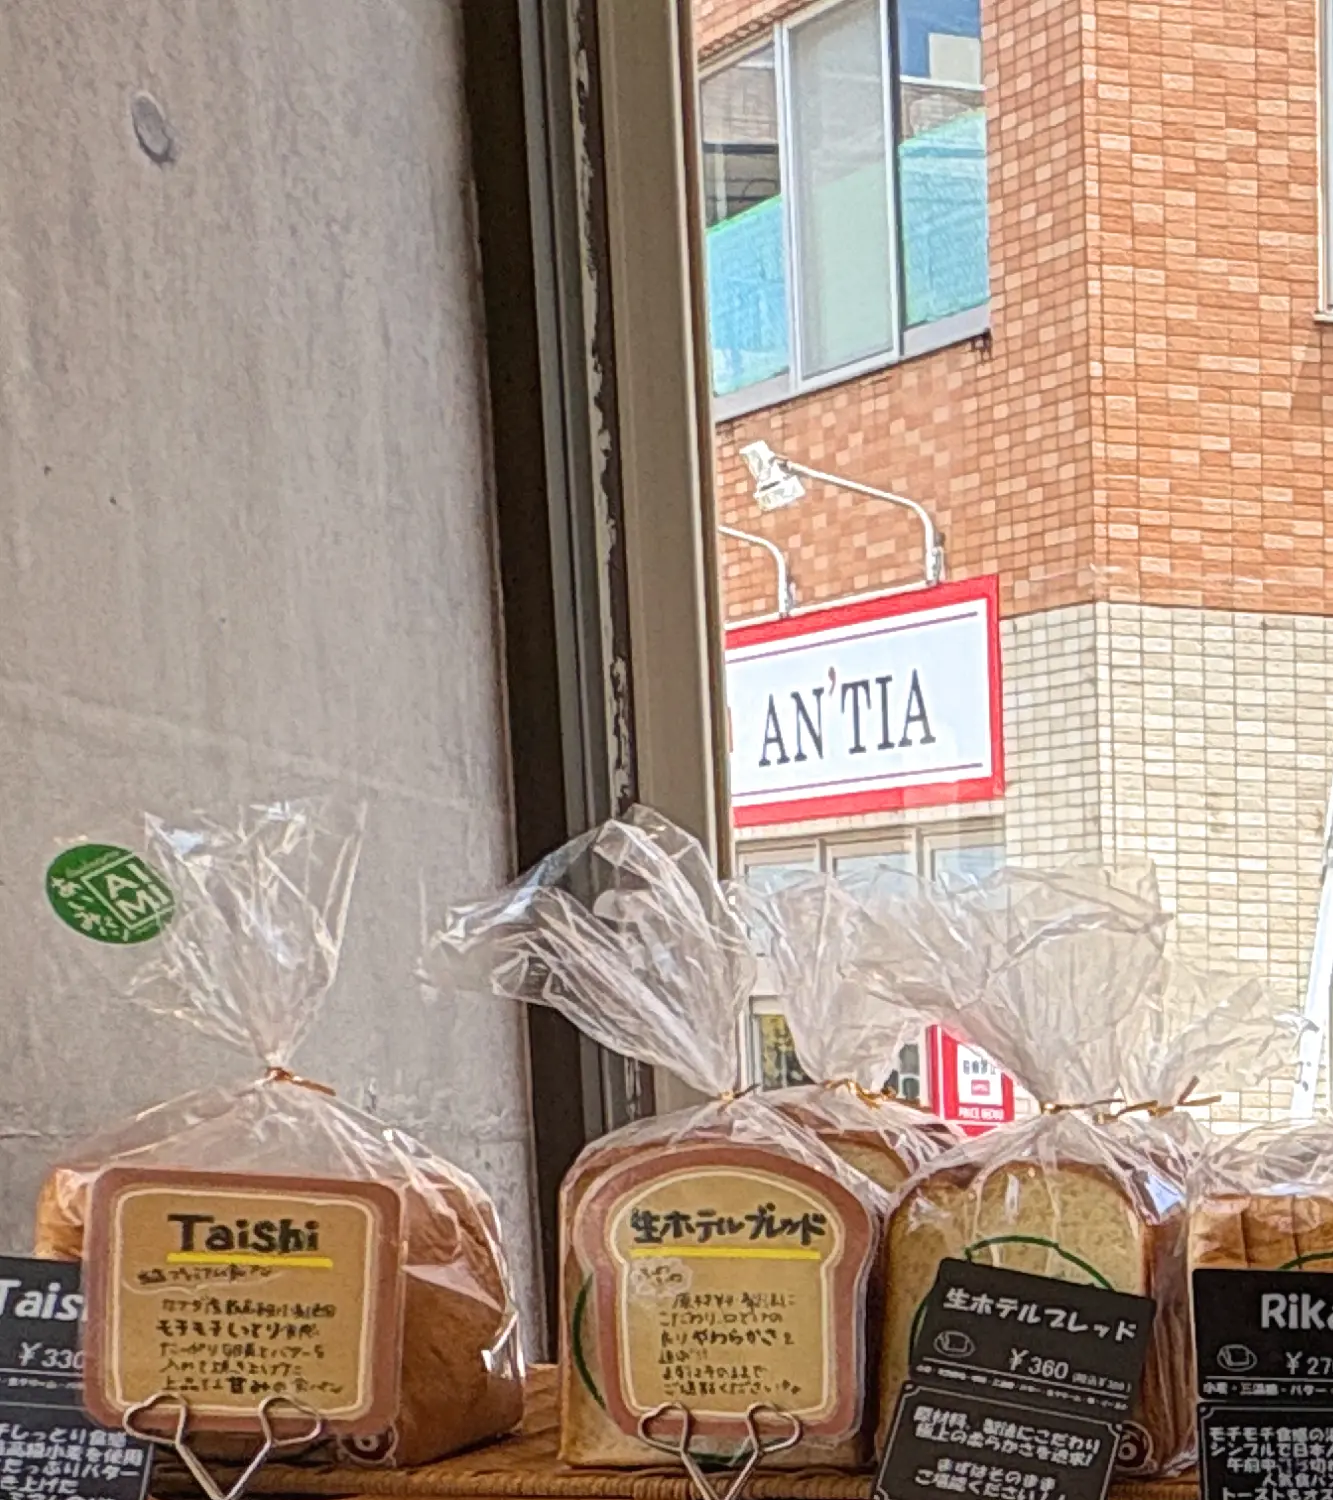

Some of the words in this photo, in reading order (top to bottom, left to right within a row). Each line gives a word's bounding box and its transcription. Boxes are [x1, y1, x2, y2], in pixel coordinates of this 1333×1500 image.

[758, 666, 936, 767] AN'TIA
[167, 1213, 320, 1255] Taishi
[629, 1202, 829, 1246] 生ホテルブレッド
[0, 1280, 88, 1323] Tais
[943, 1287, 1138, 1342] 生ホテルブレッド
